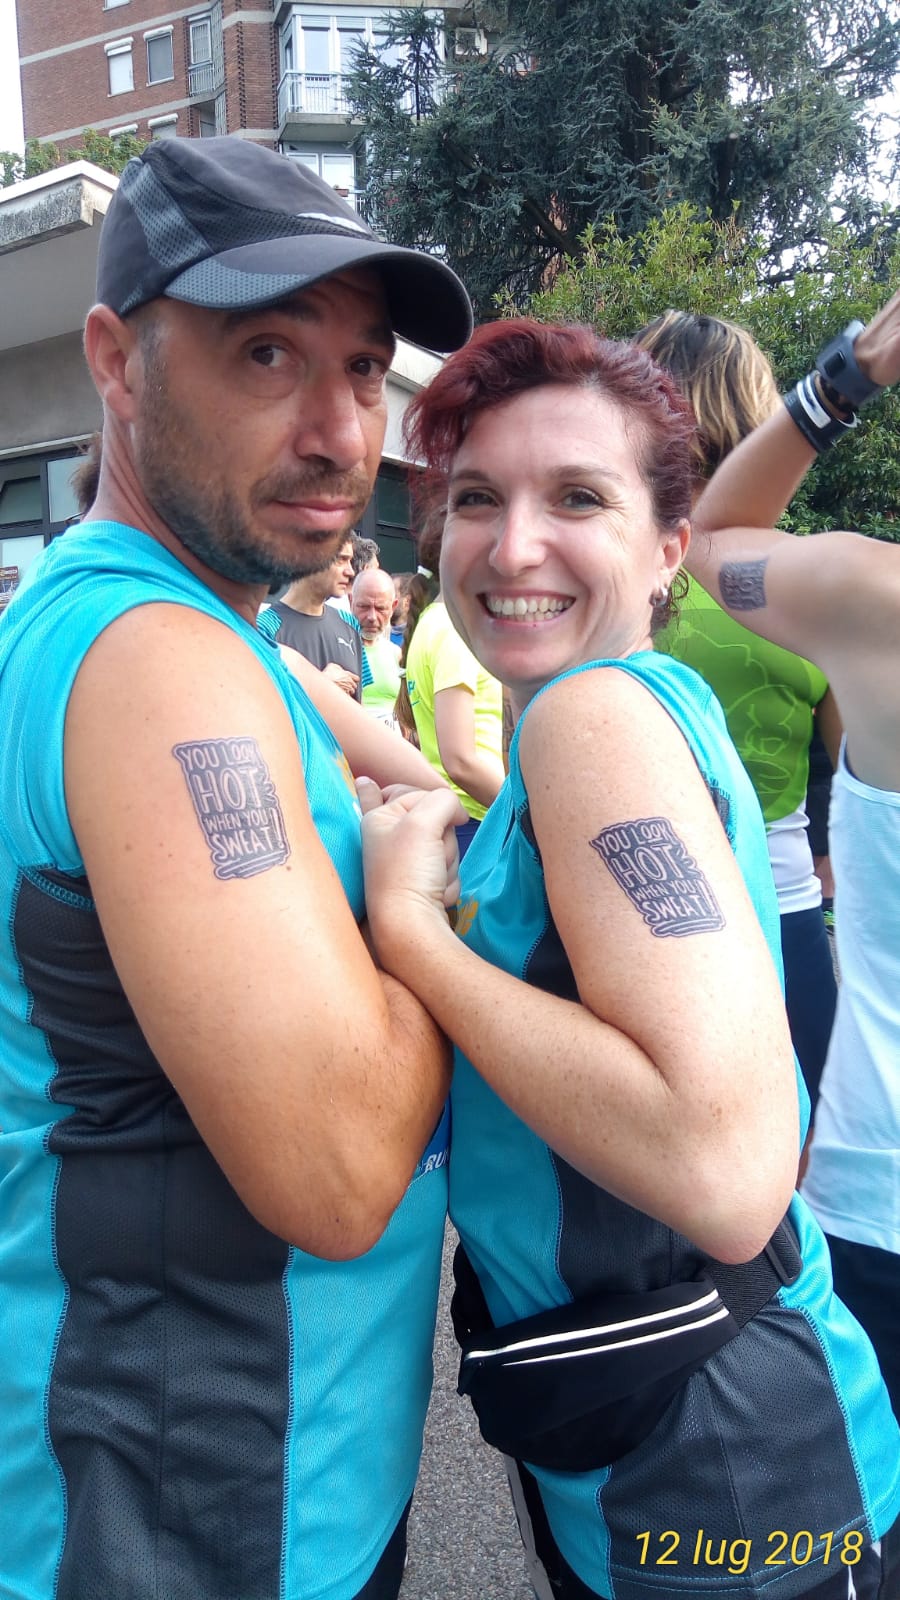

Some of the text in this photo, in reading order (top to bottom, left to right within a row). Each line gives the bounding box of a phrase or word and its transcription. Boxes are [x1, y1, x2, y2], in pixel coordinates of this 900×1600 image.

[180, 743, 263, 771] YOU LOOK
[192, 766, 262, 813] HOT
[204, 808, 269, 833] WHEN YOU
[595, 823, 678, 856] YOU LOOK
[611, 843, 685, 887] HOT
[631, 880, 698, 902] WHEN YOU
